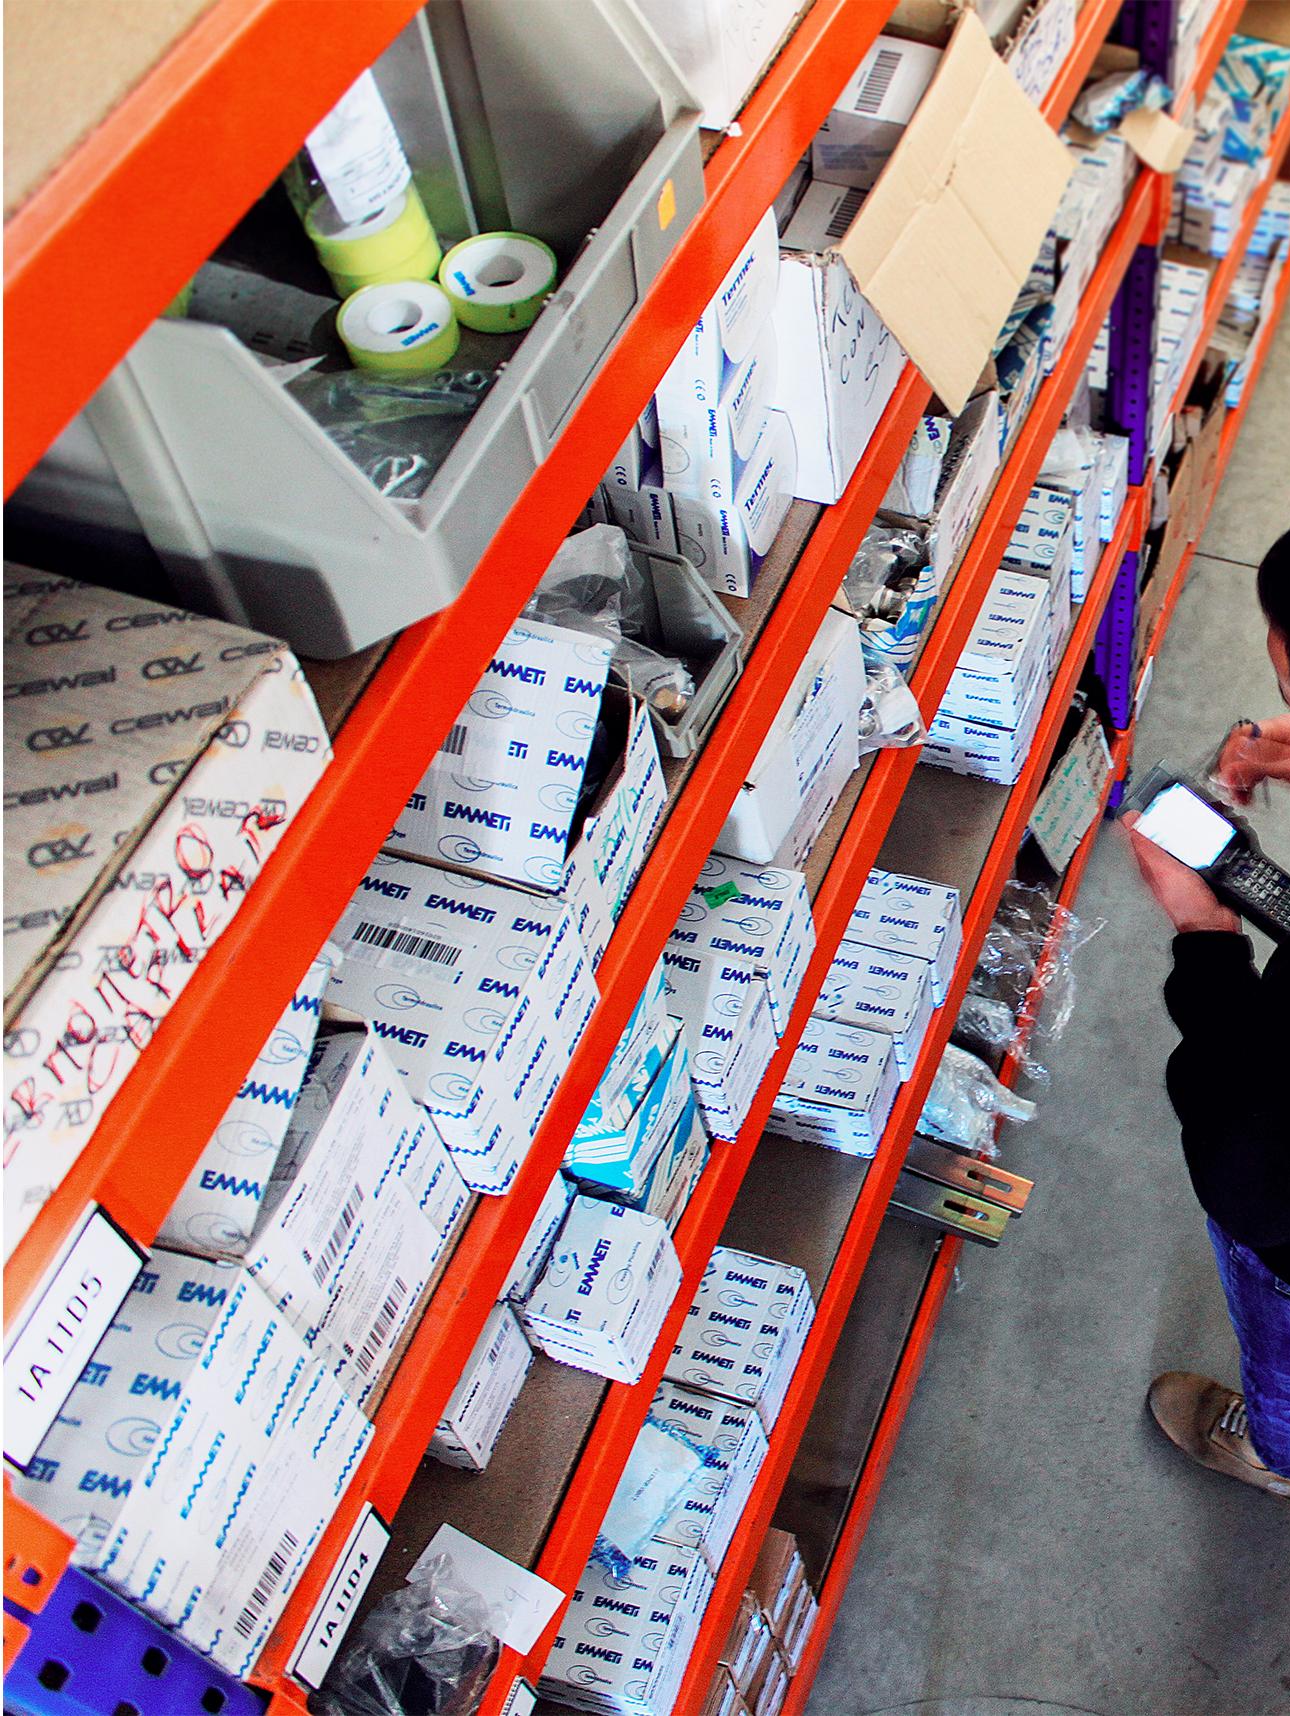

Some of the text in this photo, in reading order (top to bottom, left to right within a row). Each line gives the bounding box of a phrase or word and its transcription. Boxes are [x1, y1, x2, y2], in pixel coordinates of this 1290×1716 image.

[443, 801, 512, 832] EMMETi
[424, 893, 497, 924] EMMETi
[577, 1238, 612, 1296] EMMETi
[724, 1271, 768, 1290] EMMETi
[708, 1311, 752, 1330] EMMETi
[691, 1350, 735, 1370] EMMETi
[668, 1399, 713, 1420] EMMETi
[318, 1552, 371, 1650] 1A11D4
[592, 1595, 641, 1617] EMMETi
[574, 1642, 623, 1665] EMMETi
